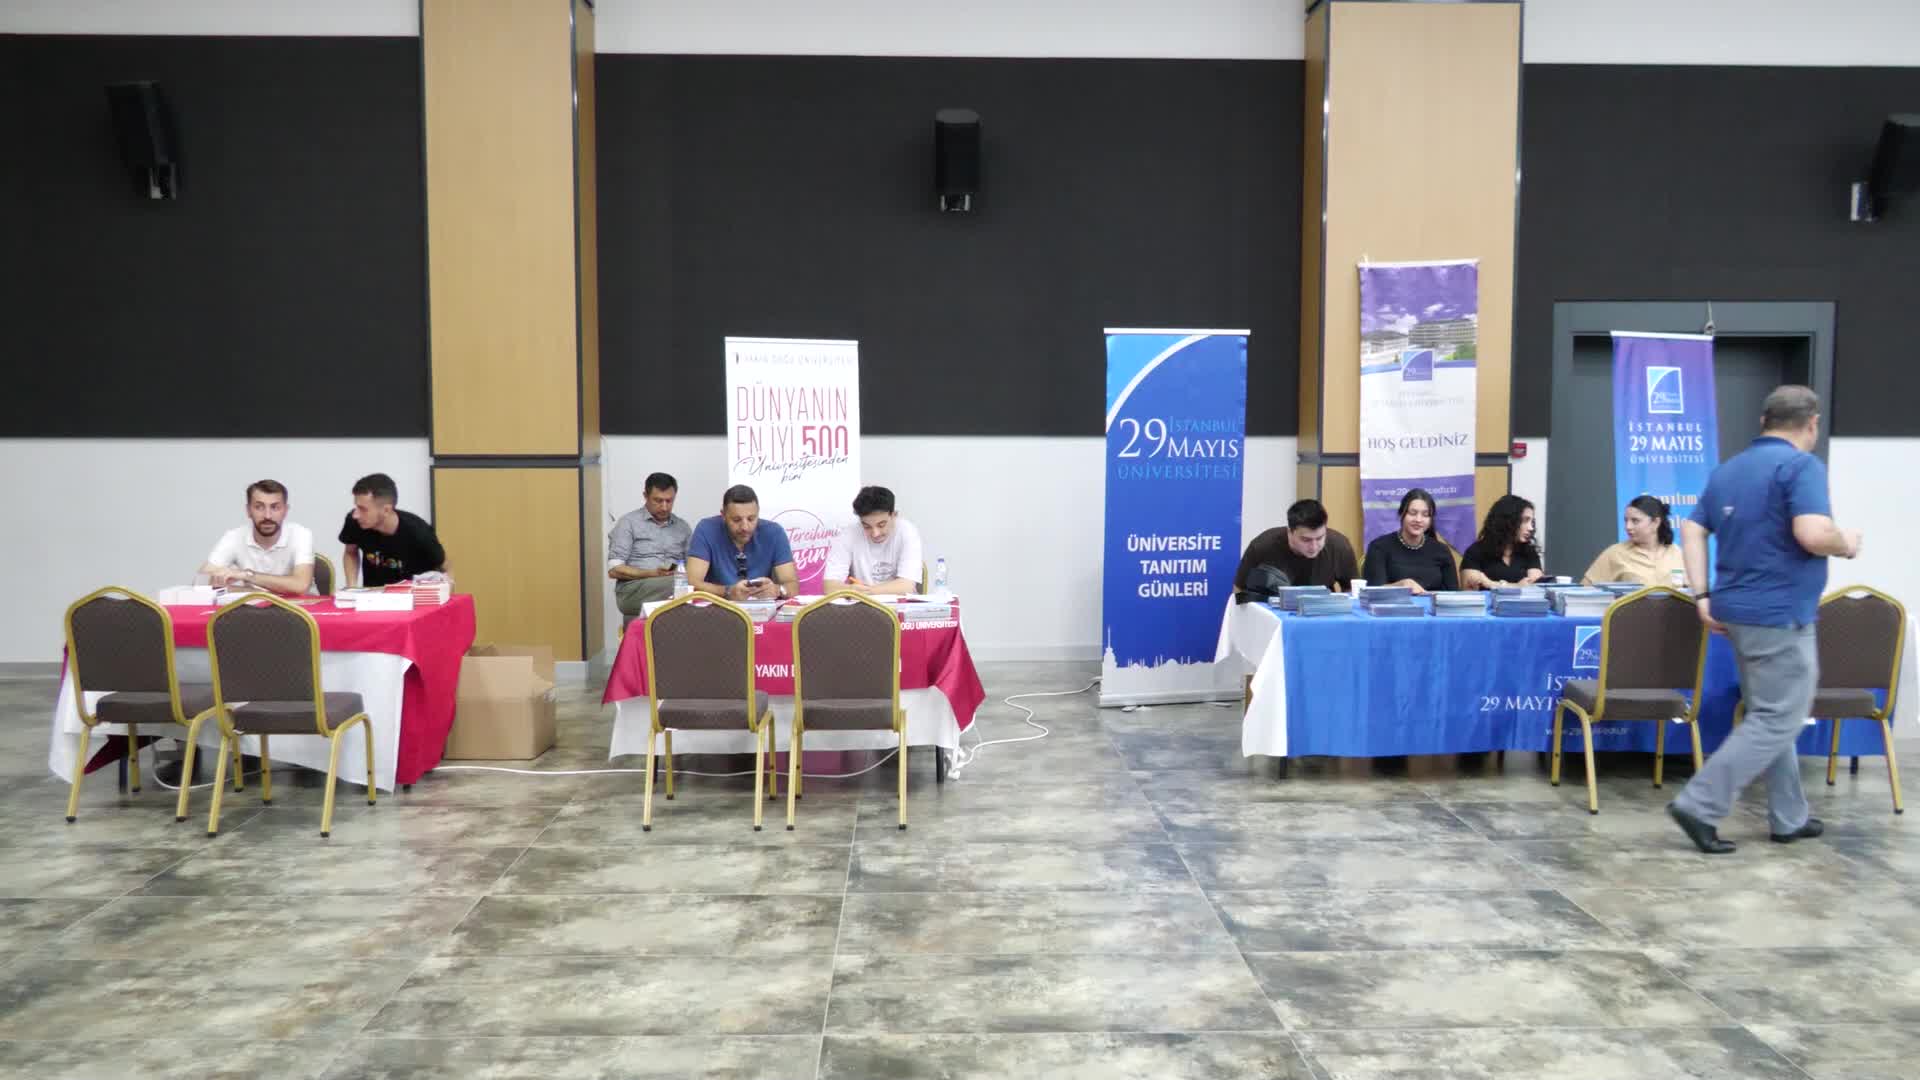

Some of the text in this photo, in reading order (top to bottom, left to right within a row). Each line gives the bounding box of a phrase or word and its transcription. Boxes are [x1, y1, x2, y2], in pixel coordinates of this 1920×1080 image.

[736, 380, 849, 422] DÜNYANIN
[737, 425, 762, 463] EN
[802, 425, 849, 458] 500
[1118, 418, 1239, 458] 29 MAYIS
[1367, 432, 1469, 453] HOŞ GELDİNİZ
[1630, 435, 1704, 451] 29 MAYIS
[1127, 532, 1222, 552] ÜNİVERSİTE
[1140, 559, 1207, 575] TANITIM
[1138, 579, 1209, 598] GÜNLERİ
[755, 664, 789, 678] YAKIN
[1480, 695, 1500, 711] 29
